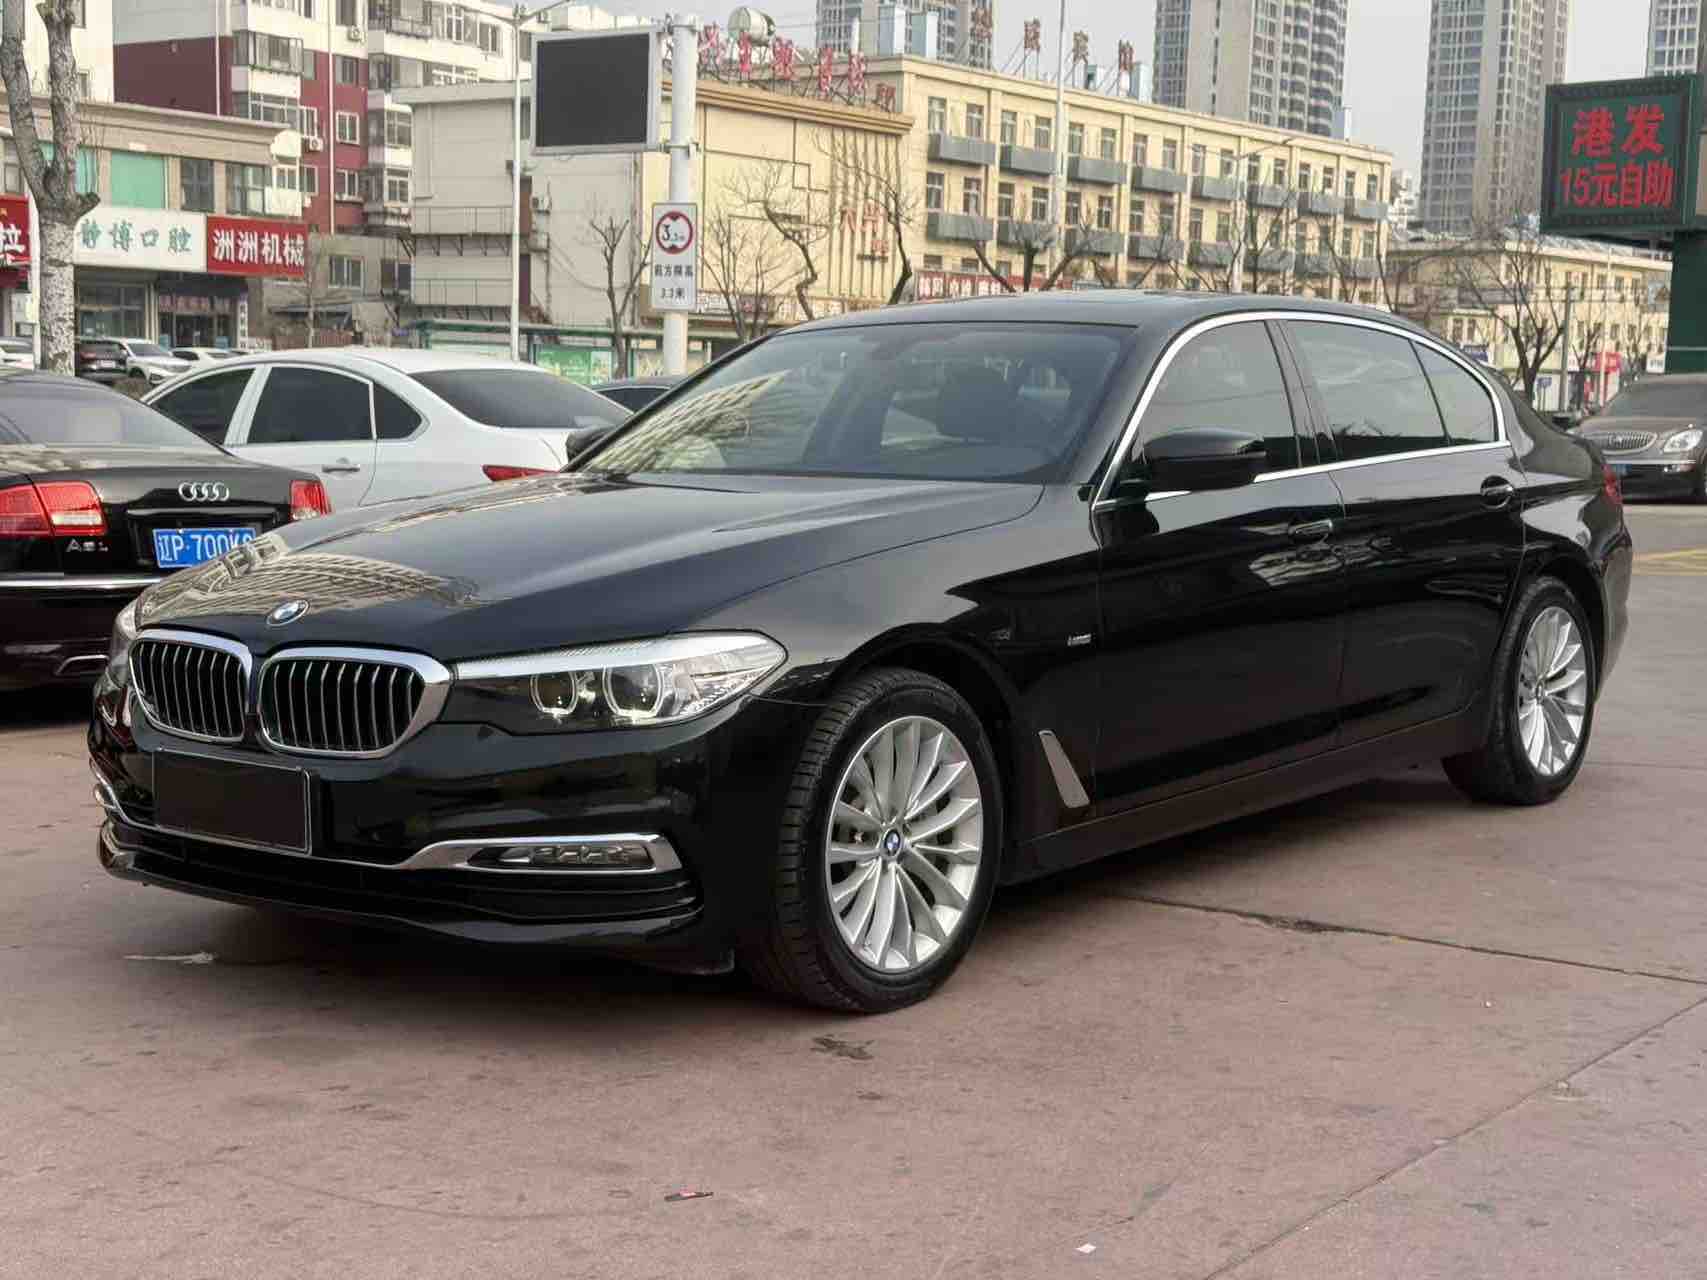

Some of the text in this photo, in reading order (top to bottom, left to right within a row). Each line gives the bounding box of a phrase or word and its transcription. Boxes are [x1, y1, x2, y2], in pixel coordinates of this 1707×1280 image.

[1571, 105, 1664, 157] 港发
[1560, 160, 1674, 209] 15元自助
[213, 228, 305, 267] 洲洲机械
